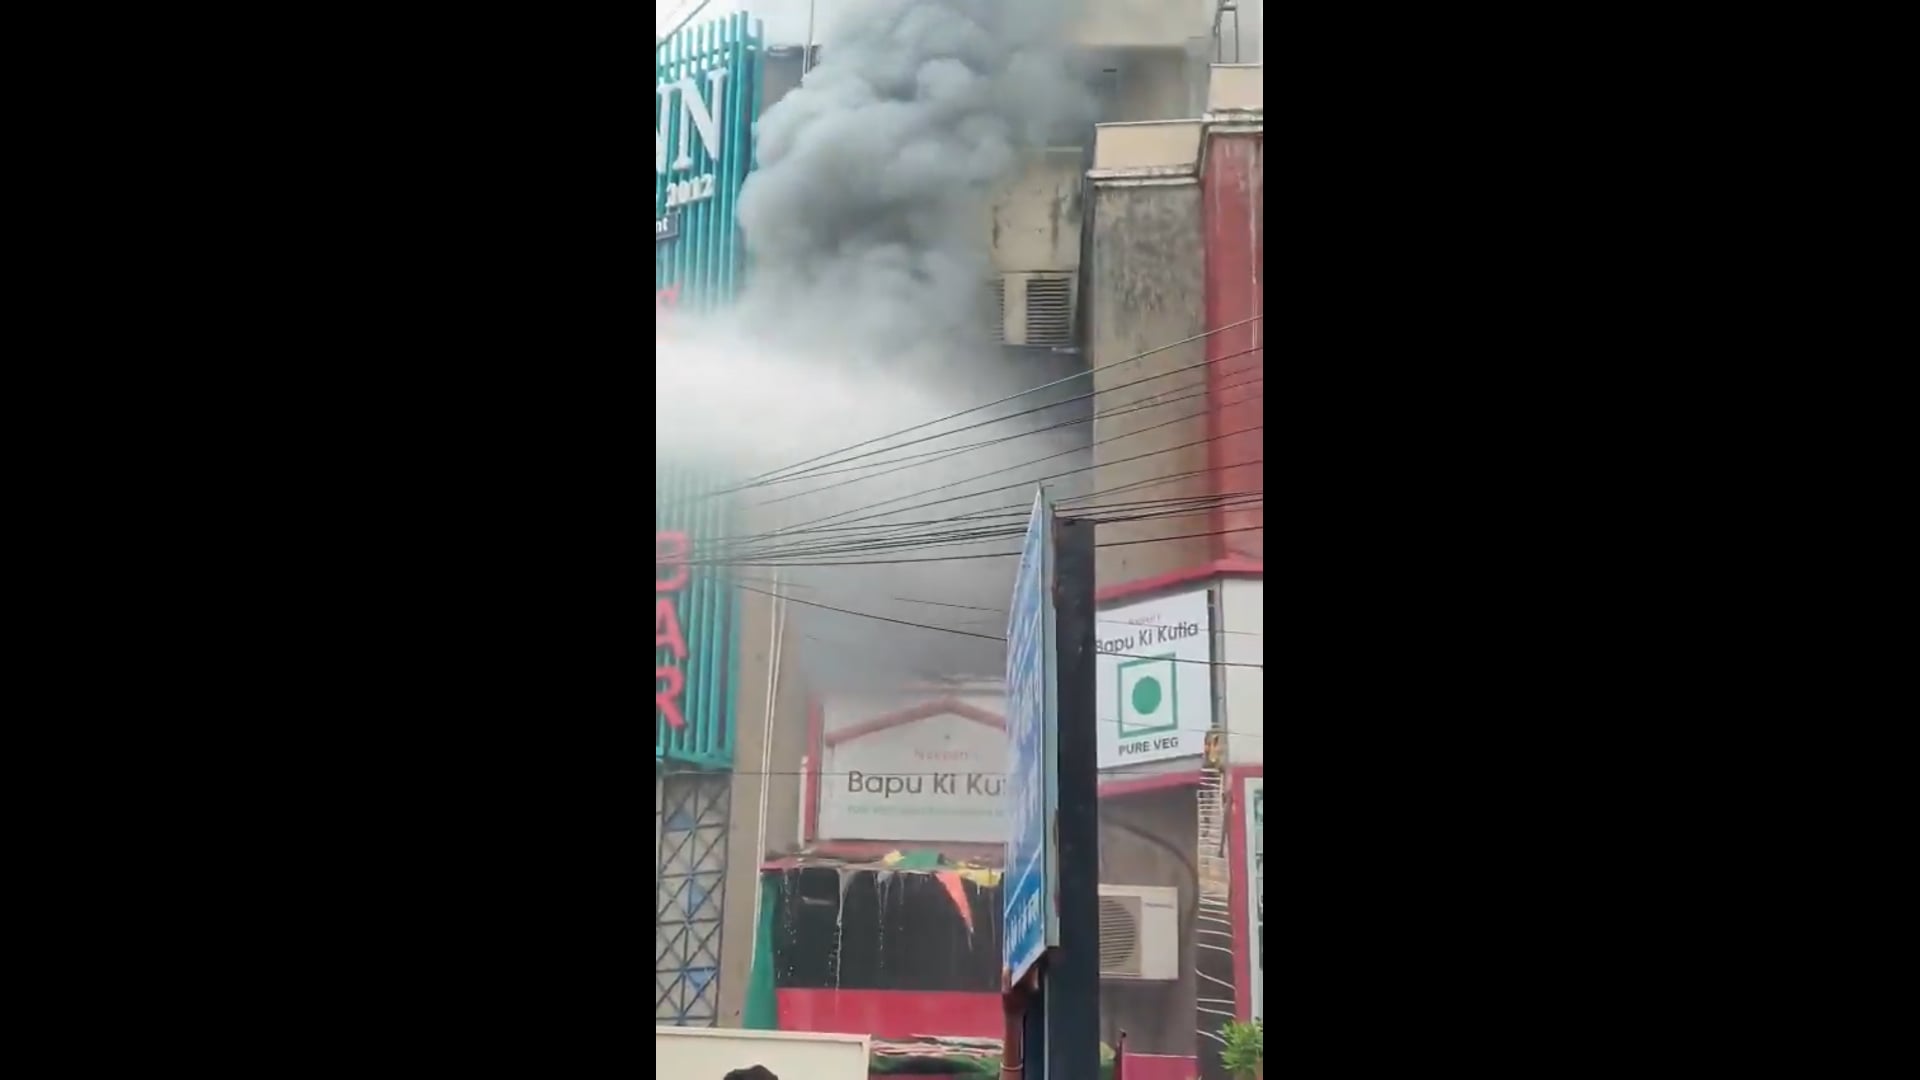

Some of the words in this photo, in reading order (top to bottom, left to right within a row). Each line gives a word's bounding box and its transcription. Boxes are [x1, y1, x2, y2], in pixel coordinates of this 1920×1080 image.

[1096, 635, 1134, 653] Bapu
[1139, 629, 1152, 647] Ki
[1158, 621, 1198, 643] Kutia
[1119, 741, 1150, 756] PURE
[1153, 736, 1178, 750] VEG
[848, 770, 922, 798] Bapu
[933, 772, 956, 794] Ki
